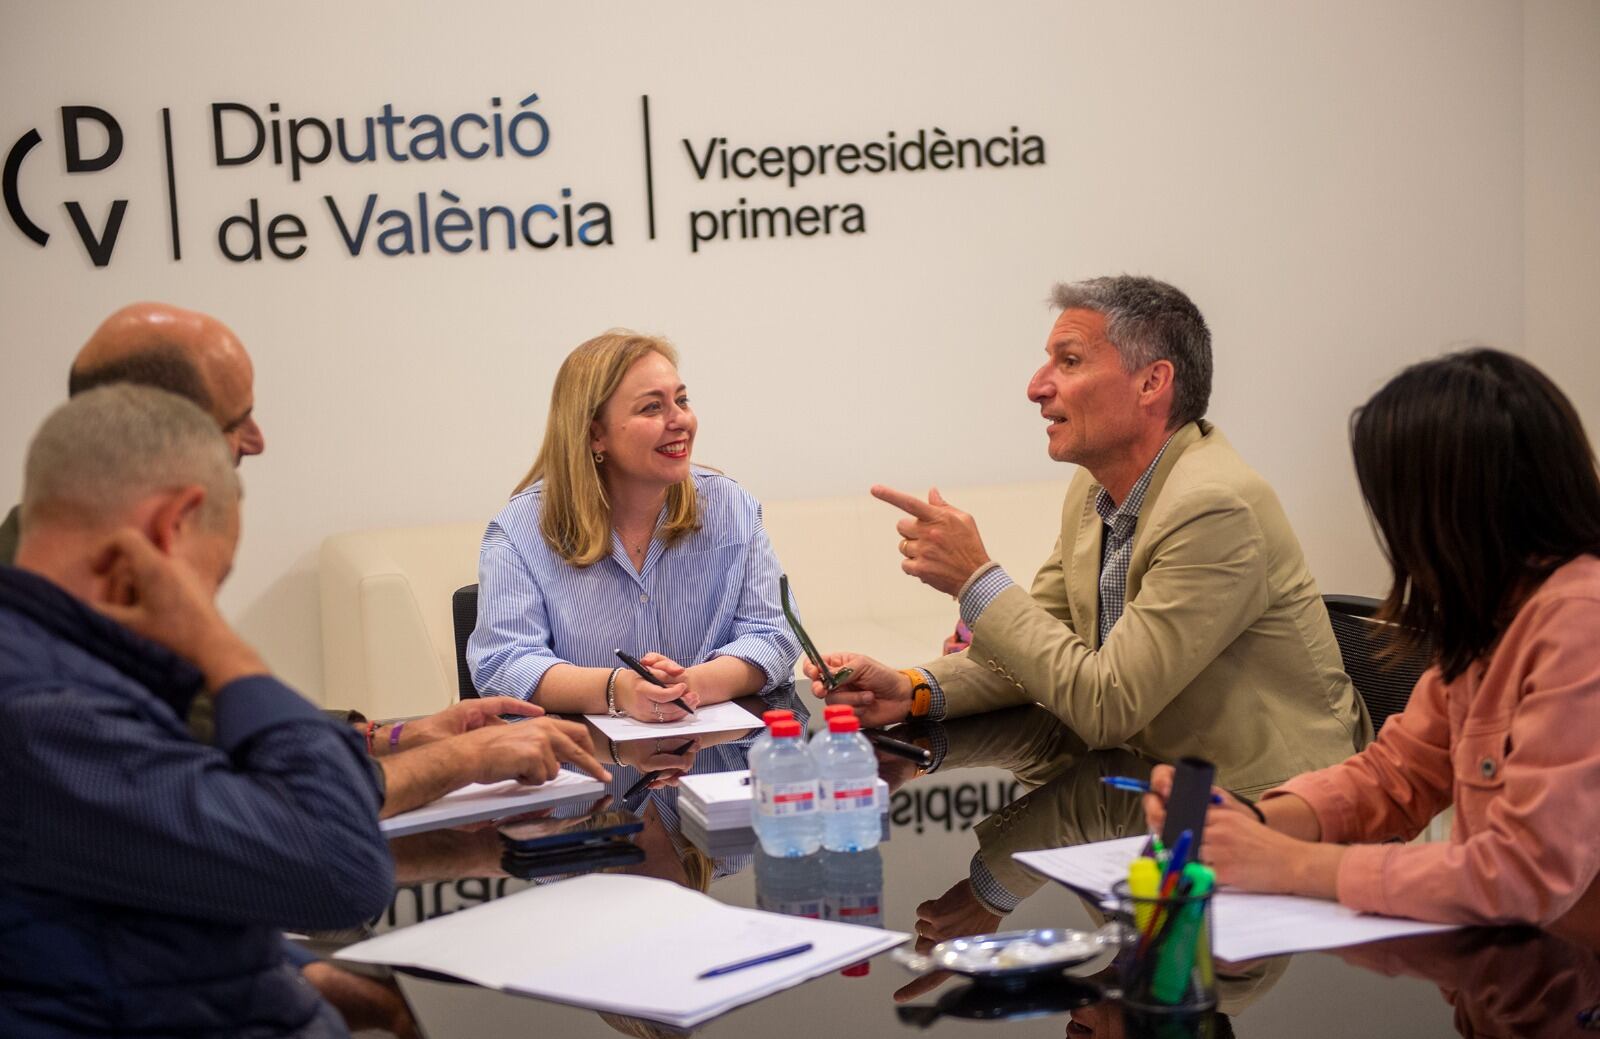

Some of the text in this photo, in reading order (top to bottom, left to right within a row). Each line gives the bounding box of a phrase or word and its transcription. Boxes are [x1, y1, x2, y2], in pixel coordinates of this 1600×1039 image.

[57, 104, 125, 176] D
[210, 93, 550, 183] Diputació
[682, 125, 1046, 189] Vicepresidència
[61, 199, 129, 269] V
[217, 187, 614, 264] de València
[689, 197, 866, 254] primera
